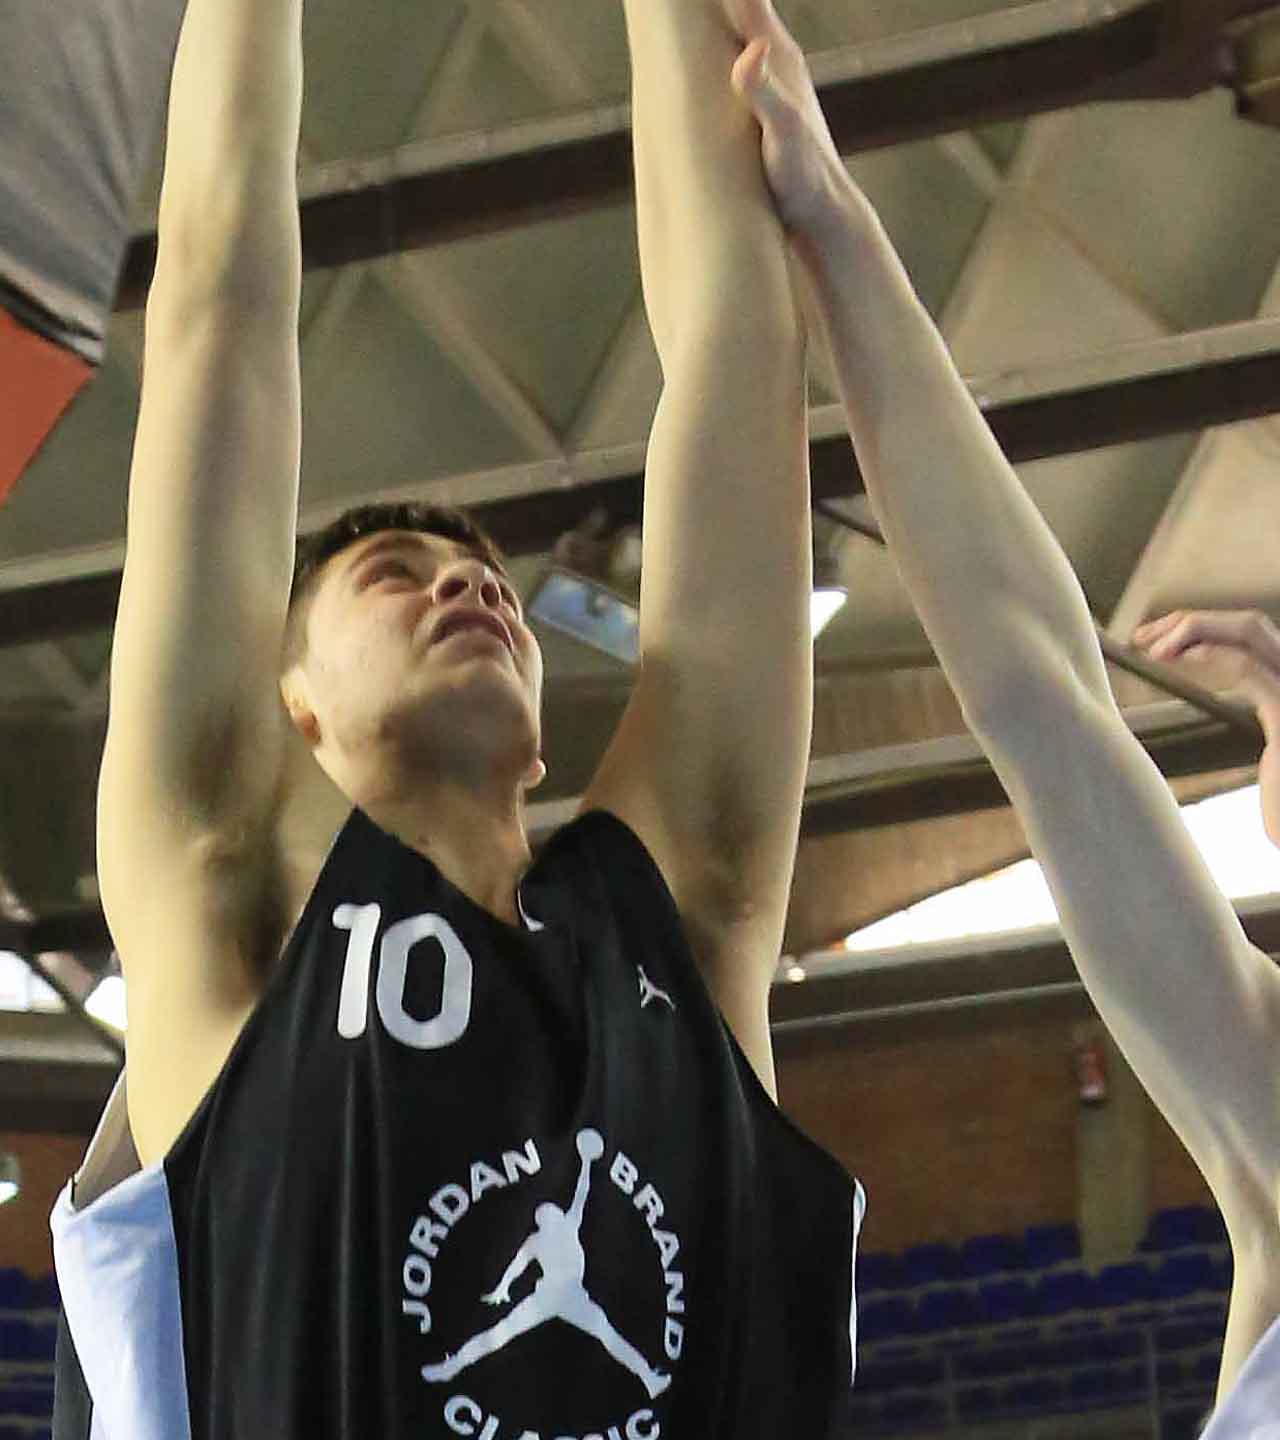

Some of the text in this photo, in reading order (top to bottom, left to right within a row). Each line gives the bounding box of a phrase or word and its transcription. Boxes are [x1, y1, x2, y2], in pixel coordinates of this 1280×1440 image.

[331, 901, 474, 1050] 10
[402, 1137, 687, 1360] JORDAN BRAND
